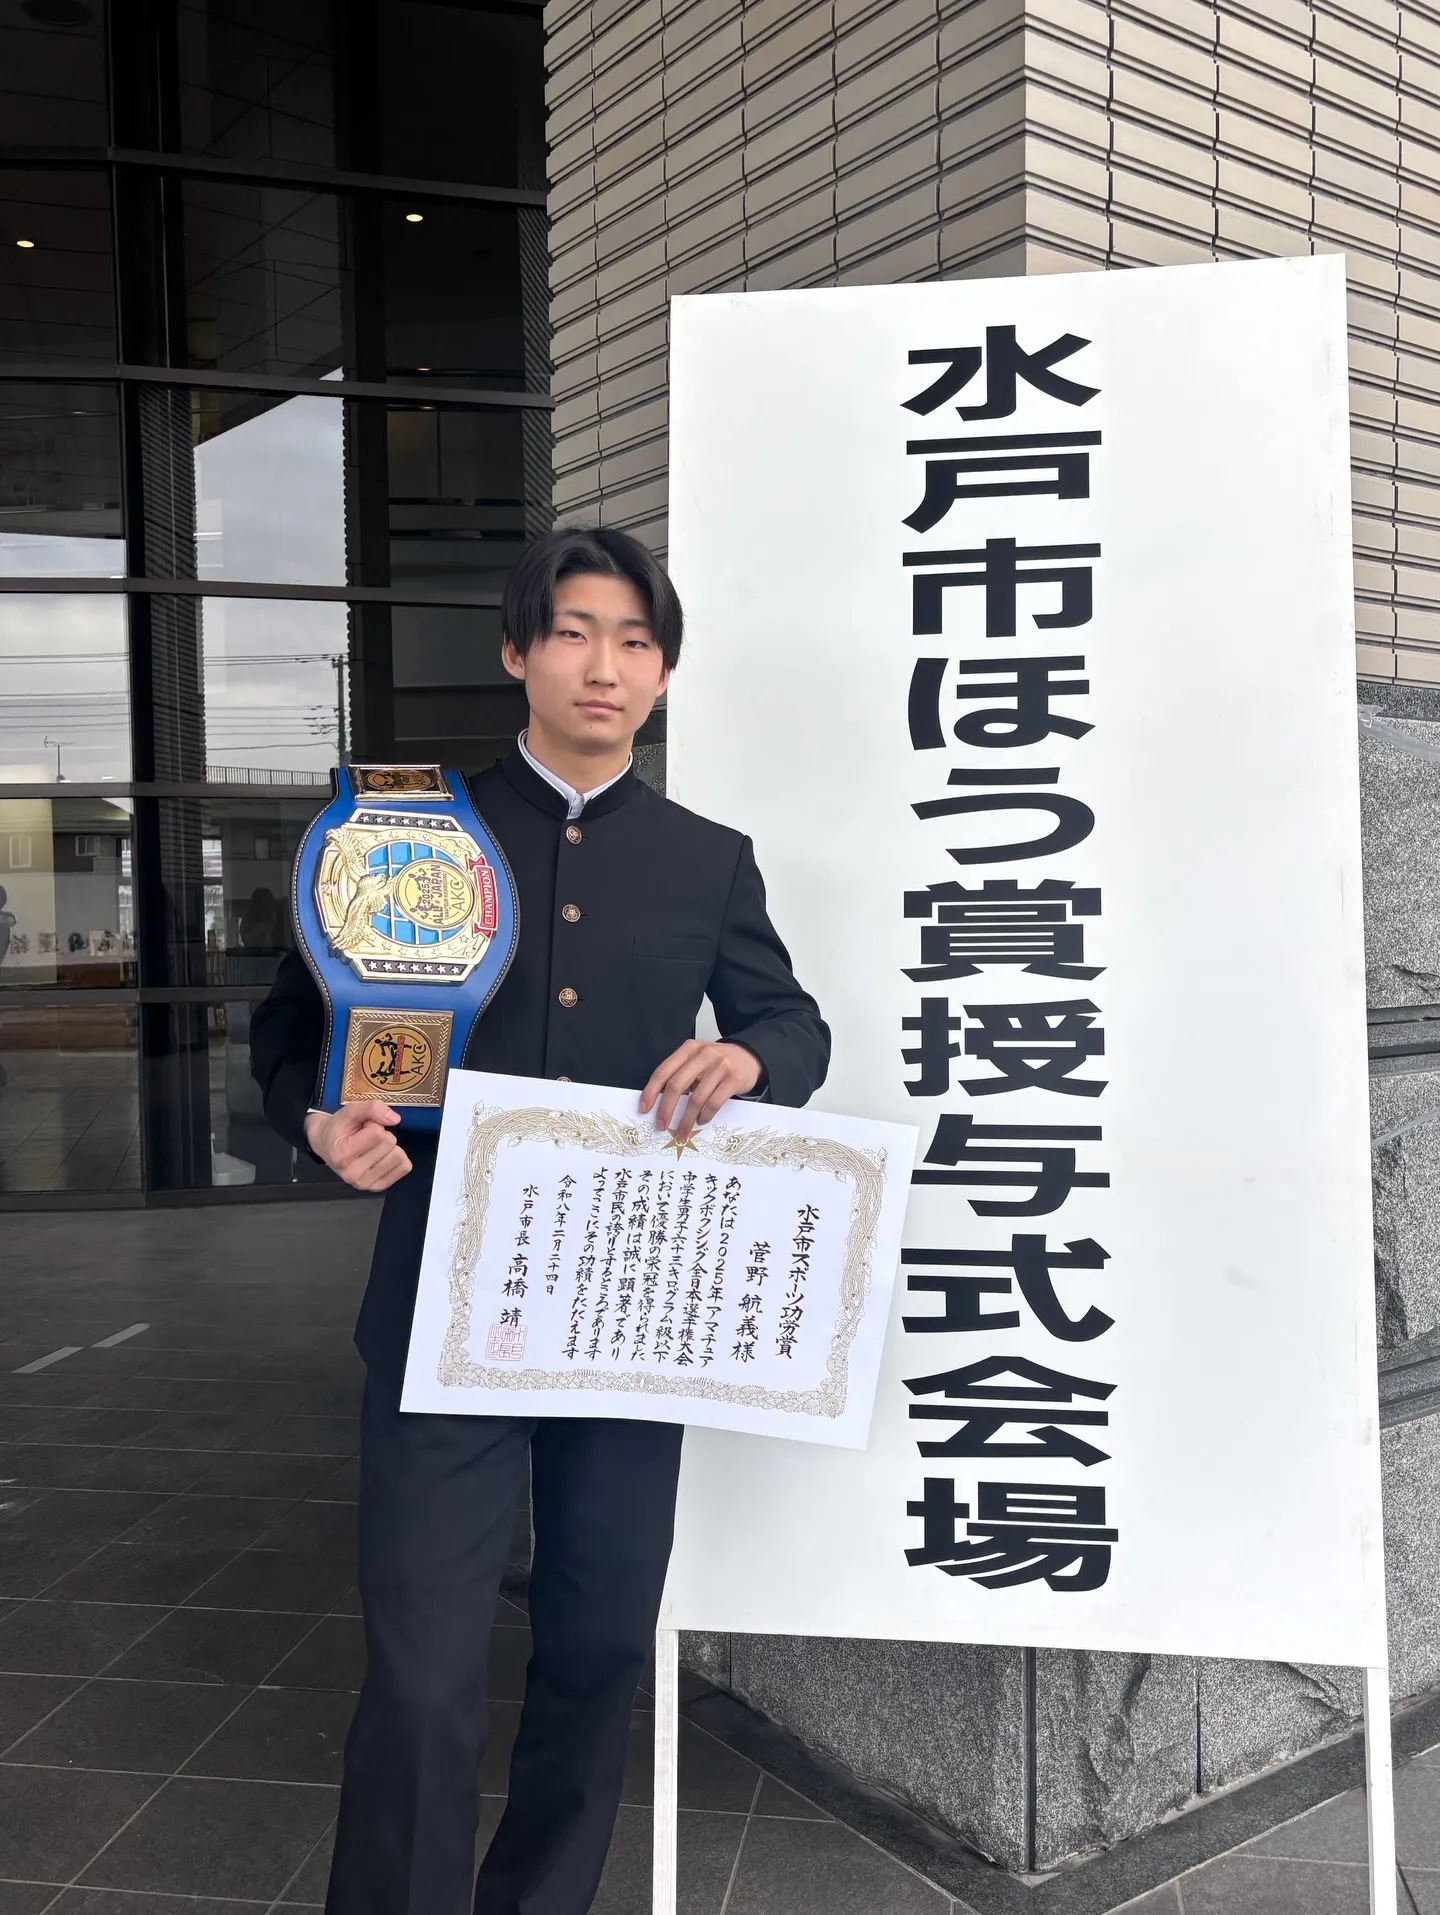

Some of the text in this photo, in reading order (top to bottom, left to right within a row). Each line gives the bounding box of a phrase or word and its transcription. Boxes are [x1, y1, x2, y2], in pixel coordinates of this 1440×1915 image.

[422, 884, 430, 904] 2025
[431, 864, 443, 925] ALL JAPAN
[451, 879, 465, 912] AKC
[481, 870, 492, 925] CHAMPION
[900, 325, 1118, 1592] 水戸市ほう賞授与式会場
[411, 1043, 427, 1076] AKC
[545, 1174, 577, 1296] 令和八年二月二十四日
[562, 1166, 608, 1361] よってここにその功績をたたえます
[584, 1168, 633, 1362] 水戸市民の誇りとするところであります
[611, 1169, 653, 1362] その成績は誠に顕著であり
[631, 1170, 675, 1362] において優勝の栄冠を得られました
[652, 1171, 697, 1363] 中学生男子六十三キログラム級以下
[673, 1173, 718, 1366] キックボクシング全日本選手権大会
[775, 1204, 820, 1359] 水戸市スポーツ功労賞
